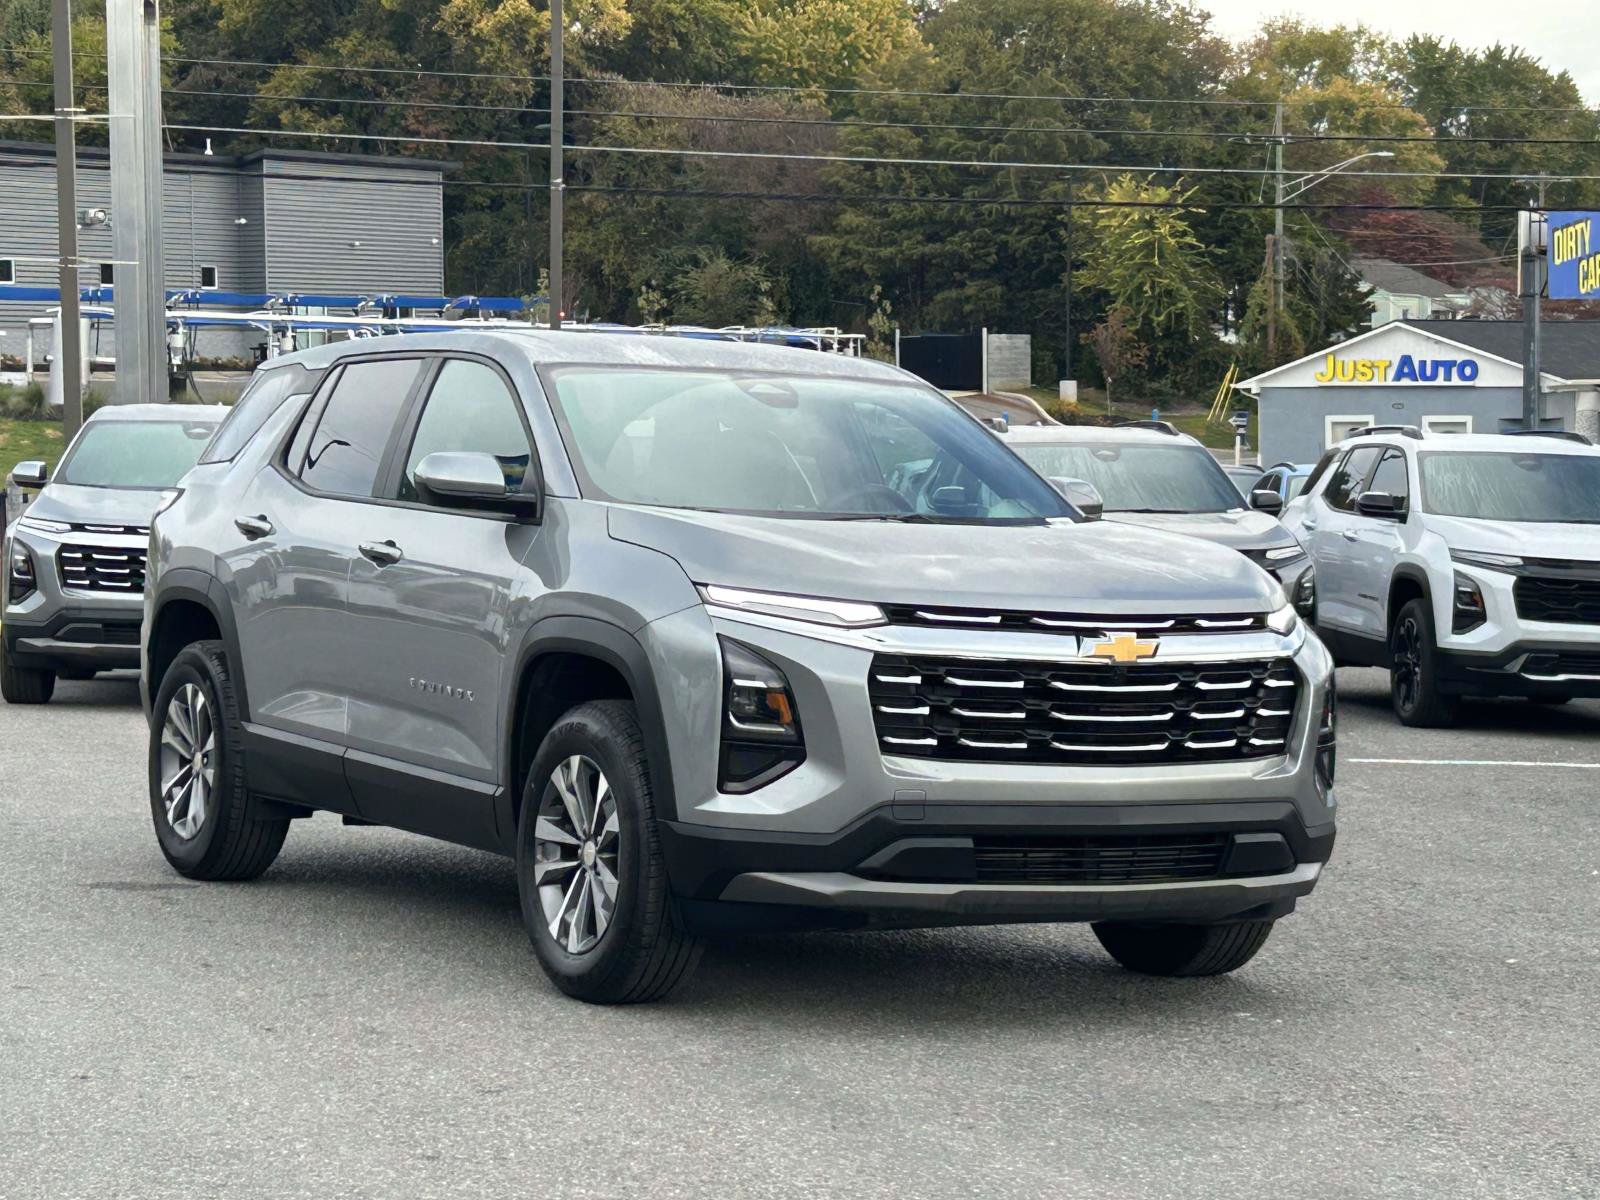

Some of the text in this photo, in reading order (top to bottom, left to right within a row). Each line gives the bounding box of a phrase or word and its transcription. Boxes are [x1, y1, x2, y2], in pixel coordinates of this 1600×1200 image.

[1553, 218, 1591, 265] DIRTY
[1315, 353, 1479, 382] JUST AUTO
